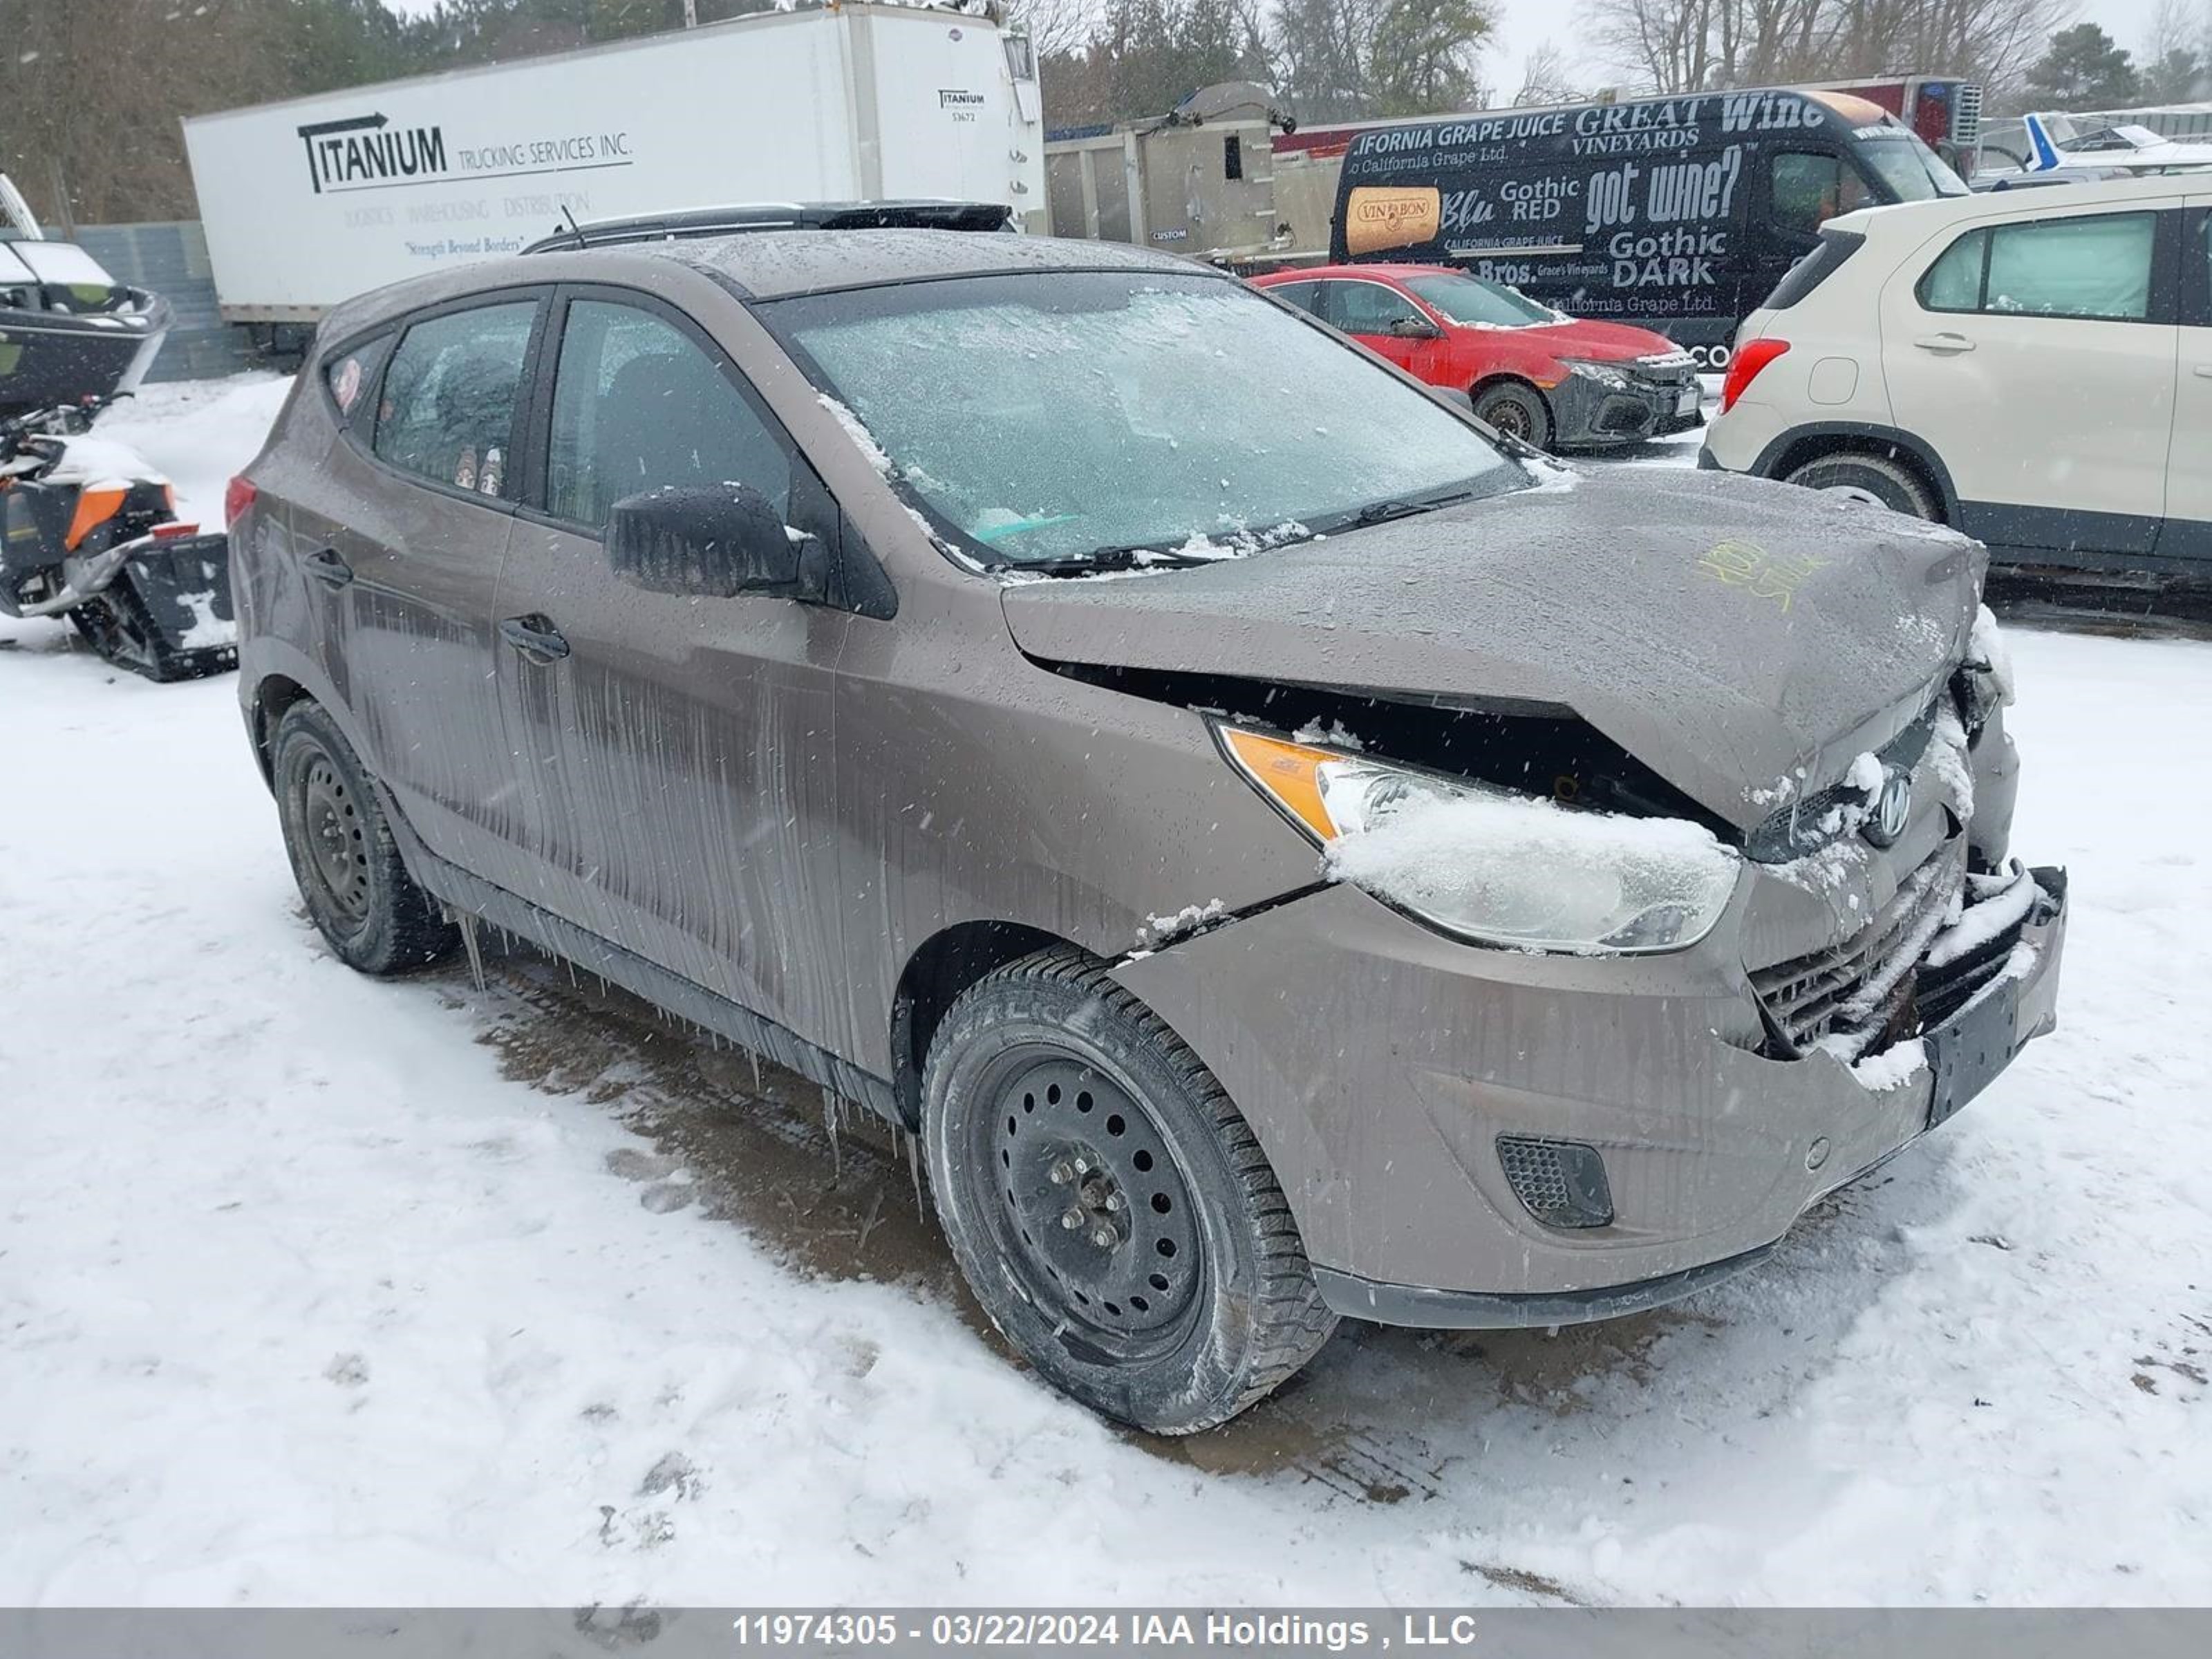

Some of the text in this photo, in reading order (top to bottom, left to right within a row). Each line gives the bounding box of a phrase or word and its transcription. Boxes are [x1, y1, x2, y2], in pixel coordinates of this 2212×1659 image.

[938, 89, 984, 109] TITANIUM
[1438, 120, 1503, 147] GRAPE
[1506, 113, 1566, 139] JUICE
[1575, 98, 1709, 137] GREAT
[297, 111, 633, 194] TITANIUM TRUCKING SERVICES INC.
[1572, 127, 1700, 156] VINEYARDS
[1362, 155, 1430, 174] California
[1433, 149, 1476, 167] Grape
[1481, 145, 1508, 162] Ltd.
[1500, 176, 1581, 202] Gothic
[1585, 144, 1743, 234] got wine?
[1364, 202, 1426, 218] VIN BON
[1441, 189, 1495, 234] Blu
[1513, 198, 1562, 221] RED
[1152, 229, 1187, 240] CUSTOM
[1444, 238, 1500, 250] CALIFORNIA
[1503, 236, 1535, 248] GRAPE
[1609, 225, 1727, 259] Gothic
[1479, 260, 1537, 284] Bros.
[1537, 261, 1609, 277] Grace's Vineyards
[1612, 256, 1716, 288] DARK
[1546, 295, 1716, 314] California Grape Ltd.
